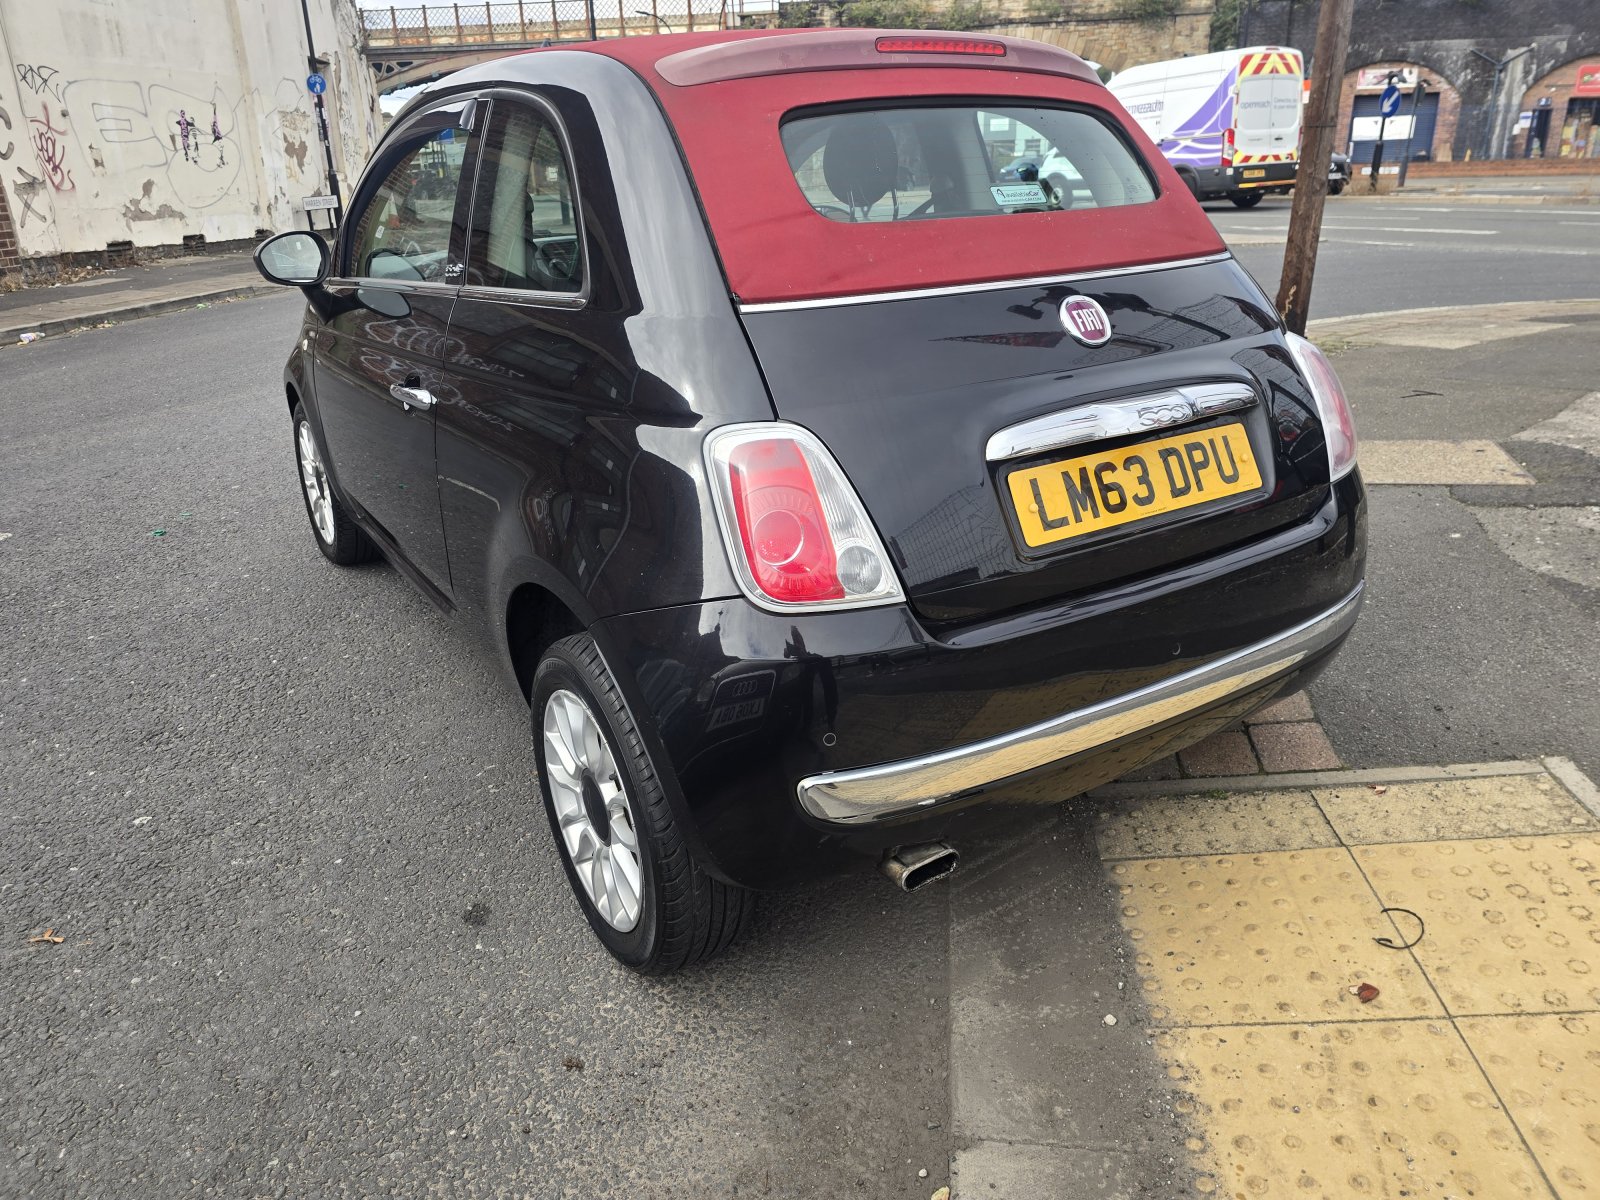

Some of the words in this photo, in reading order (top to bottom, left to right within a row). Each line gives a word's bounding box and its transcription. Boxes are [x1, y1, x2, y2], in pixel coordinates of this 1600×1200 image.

[1071, 308, 1104, 332] FIAT
[1136, 403, 1188, 427] 500
[1029, 454, 1155, 532] LM63
[1158, 435, 1240, 499] DPU
